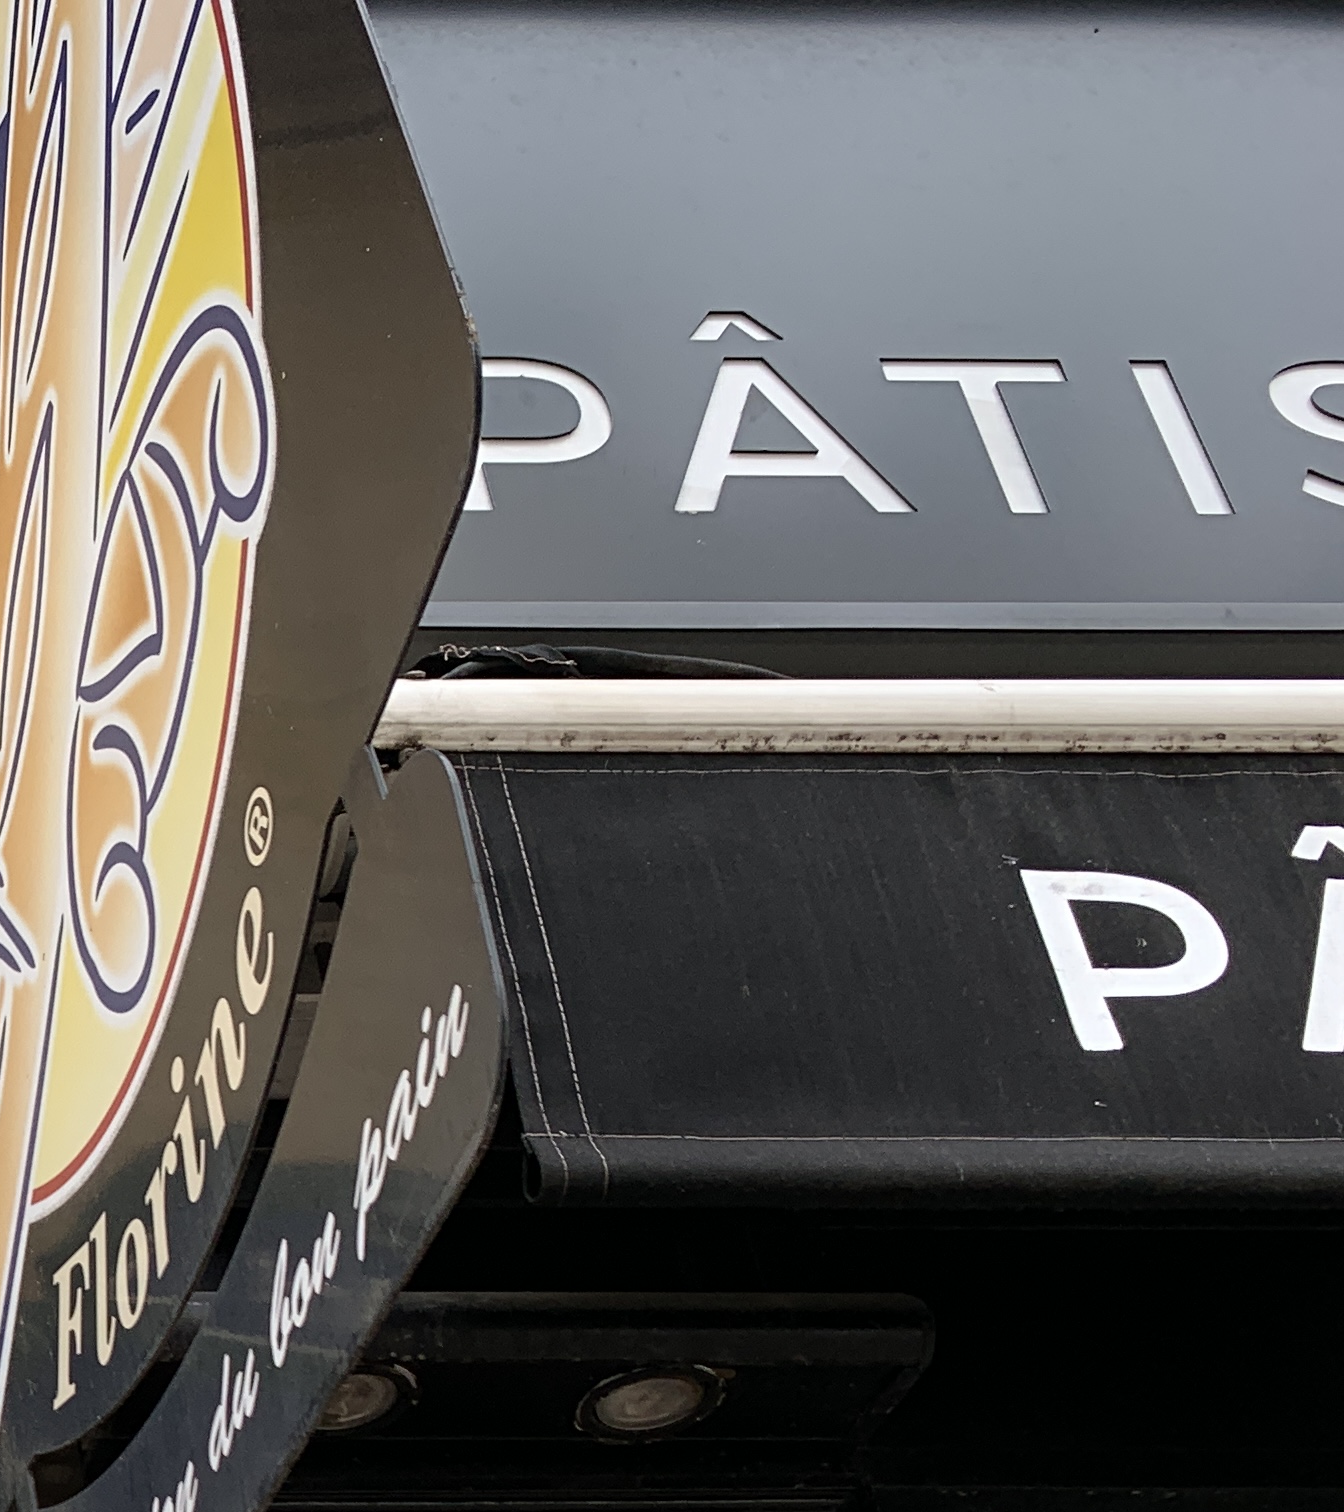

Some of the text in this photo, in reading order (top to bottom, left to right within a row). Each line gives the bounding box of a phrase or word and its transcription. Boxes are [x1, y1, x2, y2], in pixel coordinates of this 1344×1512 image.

[1020, 825, 1344, 1052] P
[208, 1348, 260, 1472] du
[269, 1211, 341, 1368] bon
[352, 984, 469, 1263] pain
